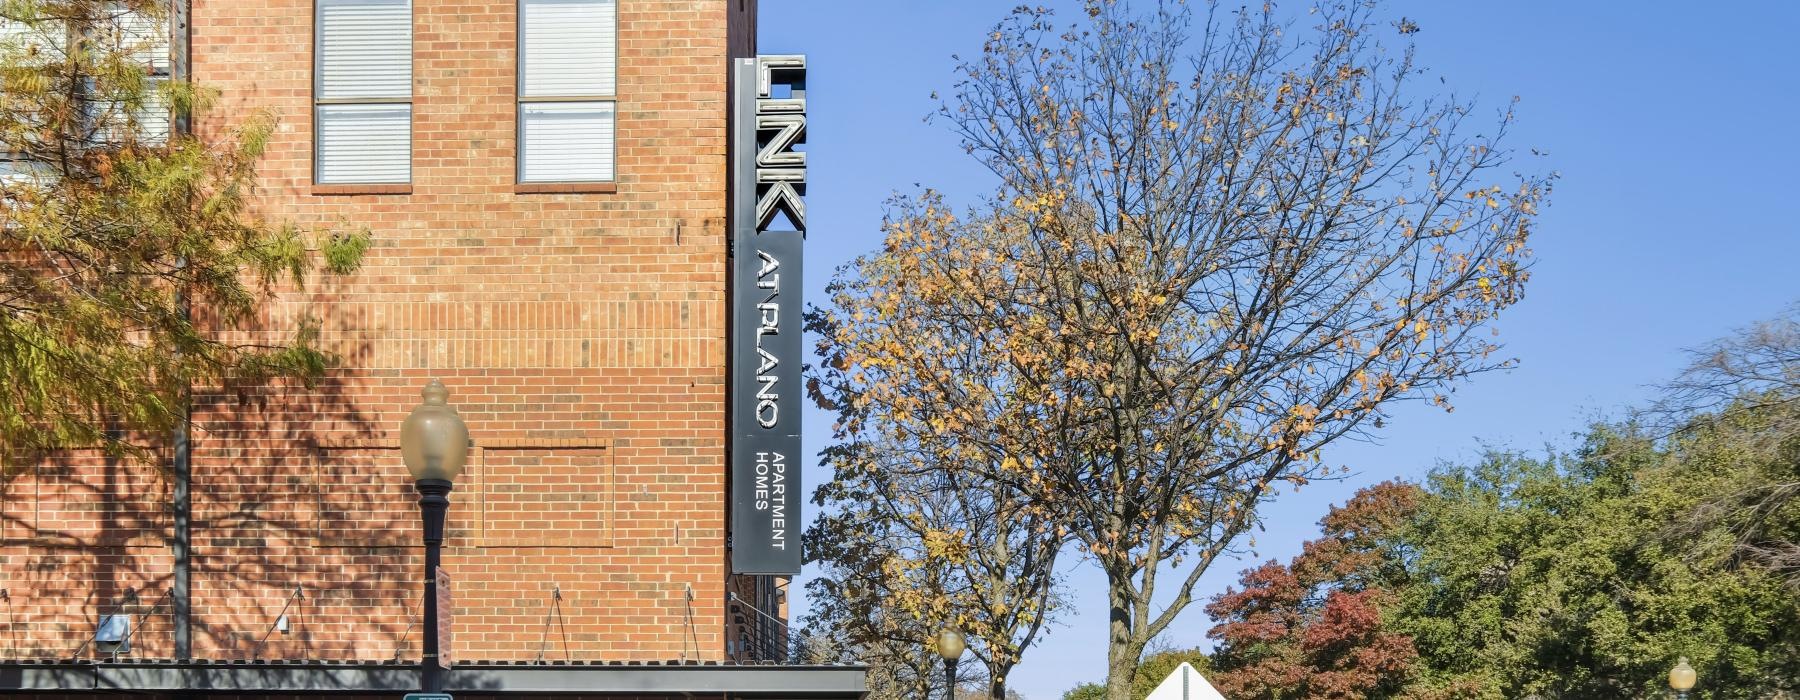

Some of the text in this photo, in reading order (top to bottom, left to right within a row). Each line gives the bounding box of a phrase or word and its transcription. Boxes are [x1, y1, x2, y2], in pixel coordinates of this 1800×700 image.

[756, 54, 807, 235] LINK
[756, 249, 780, 429] AT PLANO
[756, 452, 768, 511] HOMES
[772, 451, 785, 551] APARTMENT
